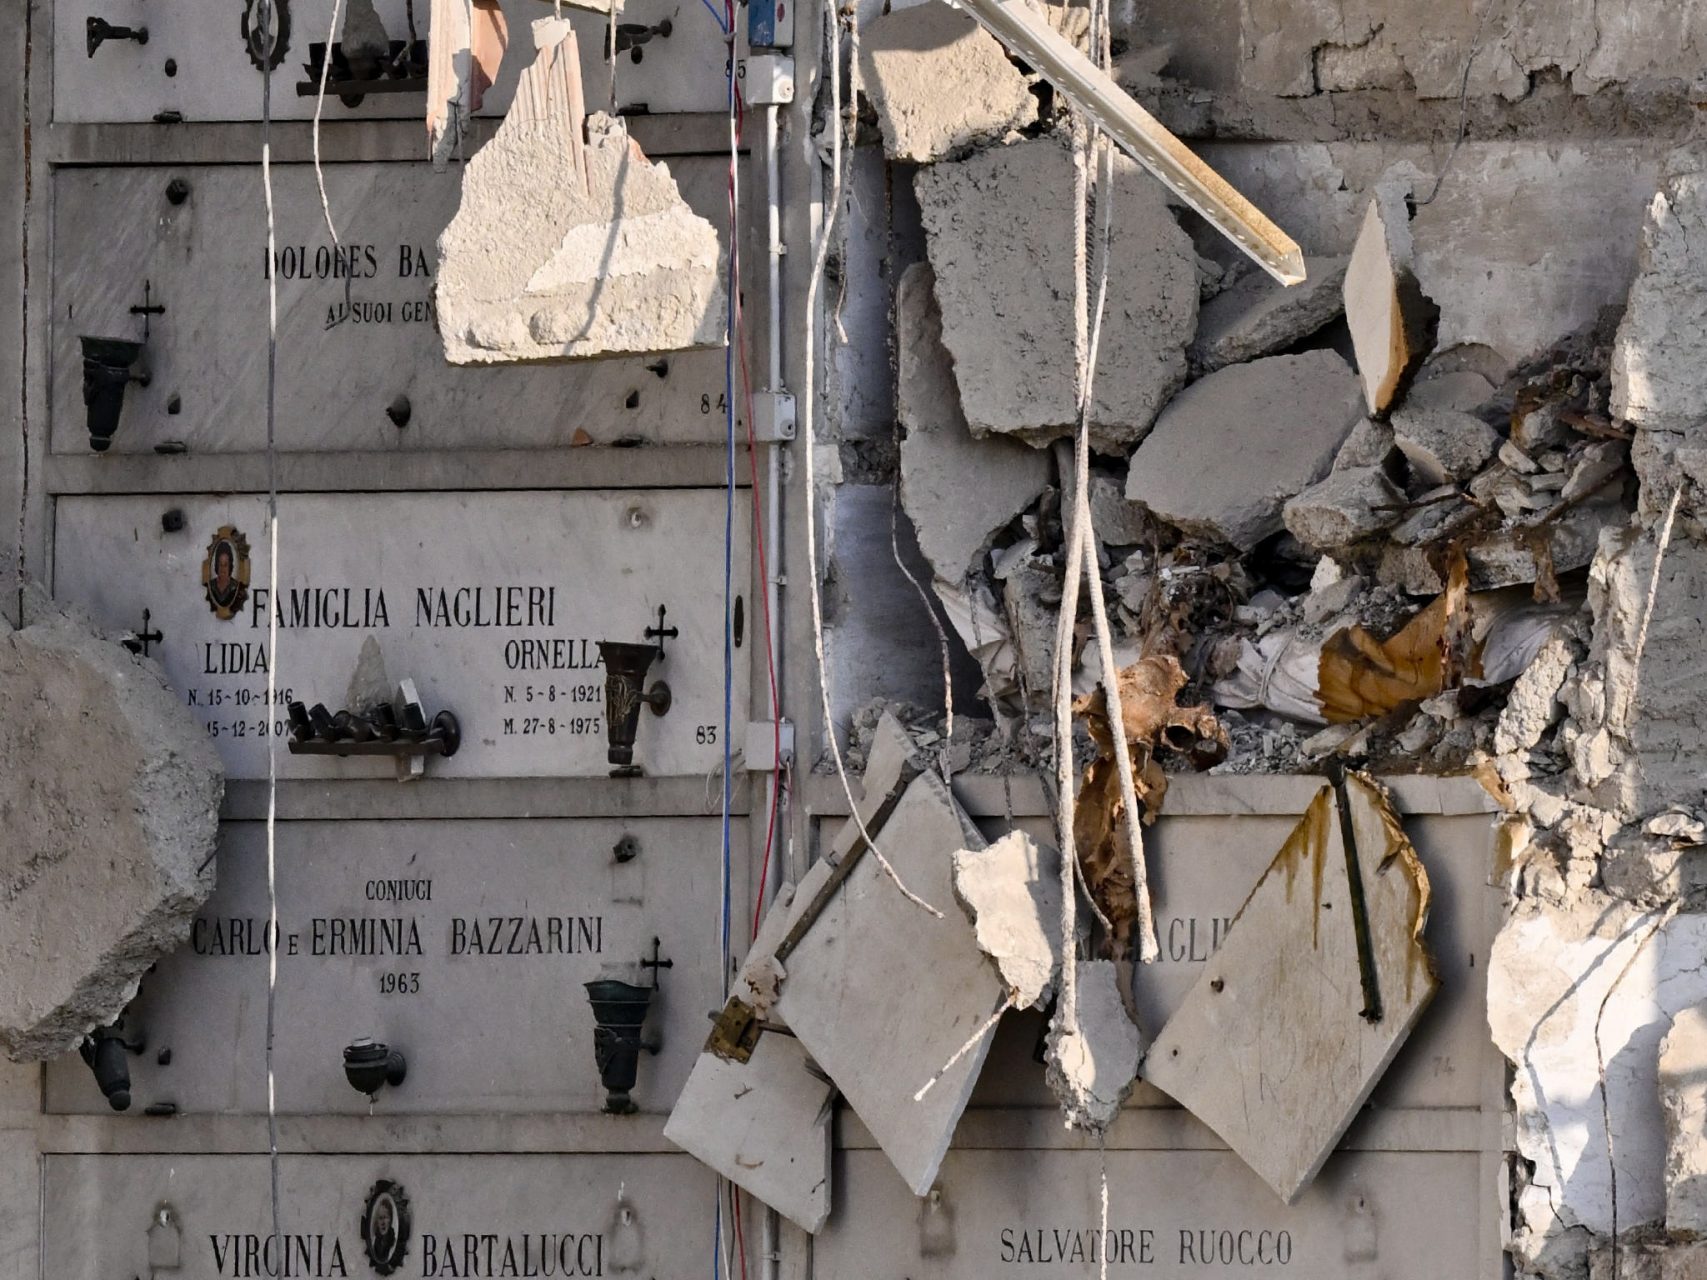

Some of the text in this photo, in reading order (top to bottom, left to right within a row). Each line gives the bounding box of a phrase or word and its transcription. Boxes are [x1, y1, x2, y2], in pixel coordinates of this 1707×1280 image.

[264, 244, 431, 280] DOLORES BA
[352, 302, 393, 323] SUOI
[700, 393, 728, 414] 84
[416, 586, 555, 626] NAGLIERI
[204, 642, 269, 674] LIDIA
[504, 685, 517, 703] N.
[504, 718, 517, 735] M.
[696, 725, 716, 745] 83
[365, 880, 432, 901] CONIUGI
[193, 916, 602, 956] CARLO E ERMINIA BAZZARINI
[380, 973, 420, 994] 1963
[209, 1234, 603, 1278] VIRGINIA BARTALUCCI
[1000, 1229, 1292, 1265] SALVATORE RUOCCO
